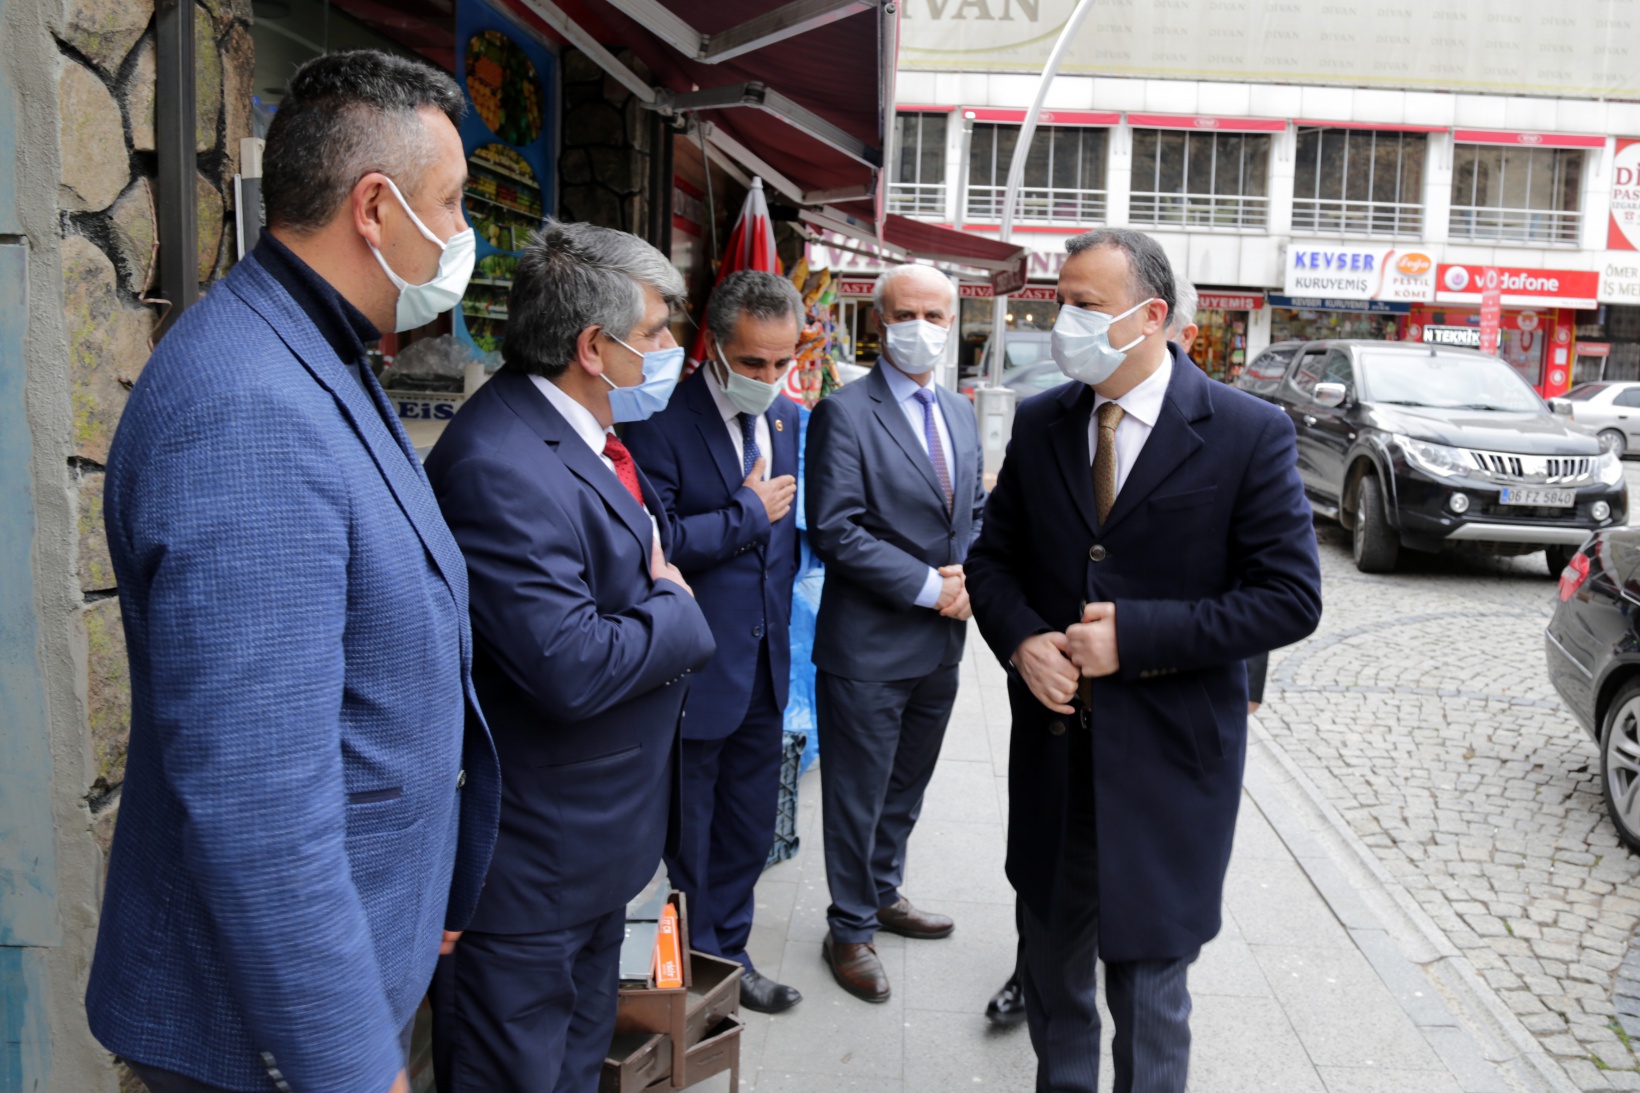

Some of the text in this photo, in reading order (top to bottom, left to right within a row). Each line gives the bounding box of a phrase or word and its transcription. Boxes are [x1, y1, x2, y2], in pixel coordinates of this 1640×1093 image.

[1295, 251, 1374, 271] KEVSER
[1605, 263, 1638, 279] ÖMER
[1295, 276, 1367, 292] KURUYEMİŞ
[1474, 271, 1559, 292] vdafone
[1618, 283, 1640, 297] ME
[1198, 296, 1254, 309] UYEMİŞ
